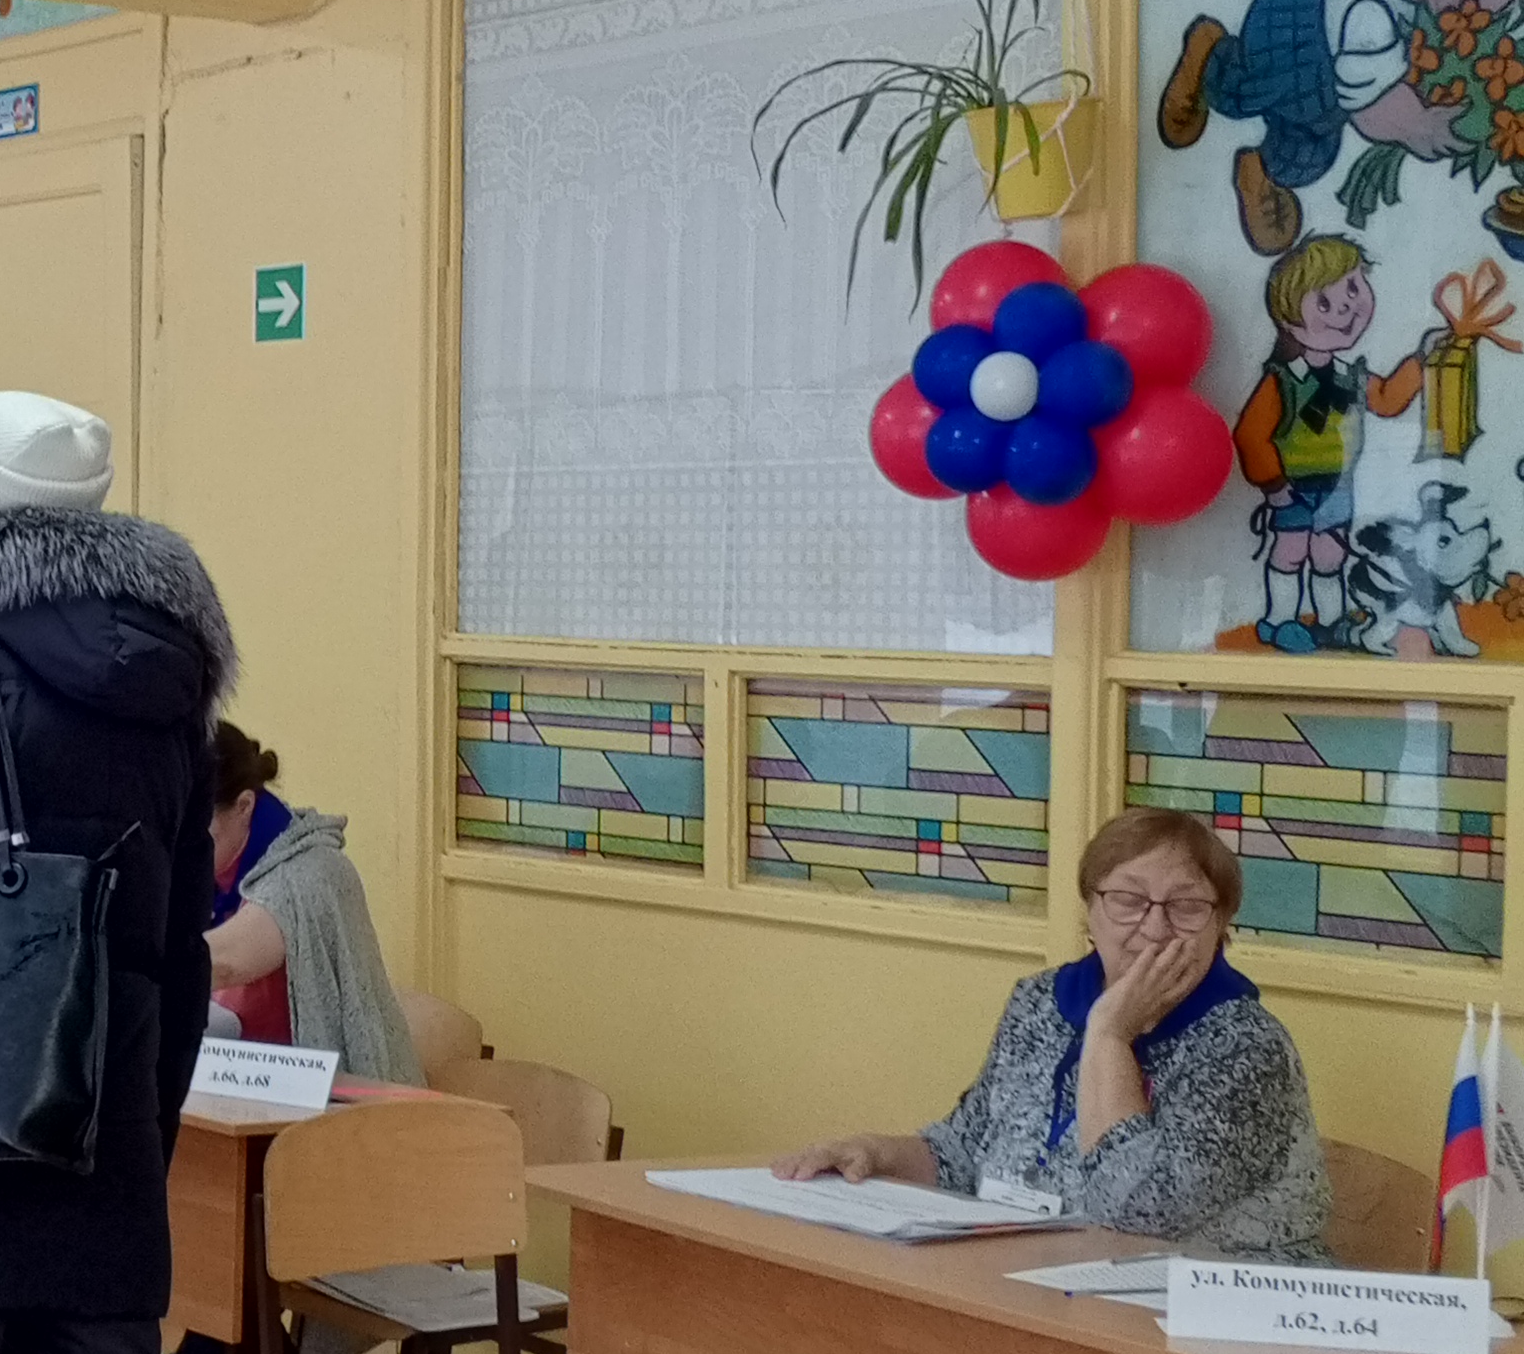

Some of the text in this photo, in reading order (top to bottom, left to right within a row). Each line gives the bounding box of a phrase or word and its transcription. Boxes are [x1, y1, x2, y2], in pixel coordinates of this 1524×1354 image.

[203, 1044, 327, 1072] оммунистическая,
[1190, 1269, 1224, 1289] ул.
[1233, 1269, 1468, 1311] Коммунистическая,
[1273, 1312, 1378, 1337] д.62, д.64
